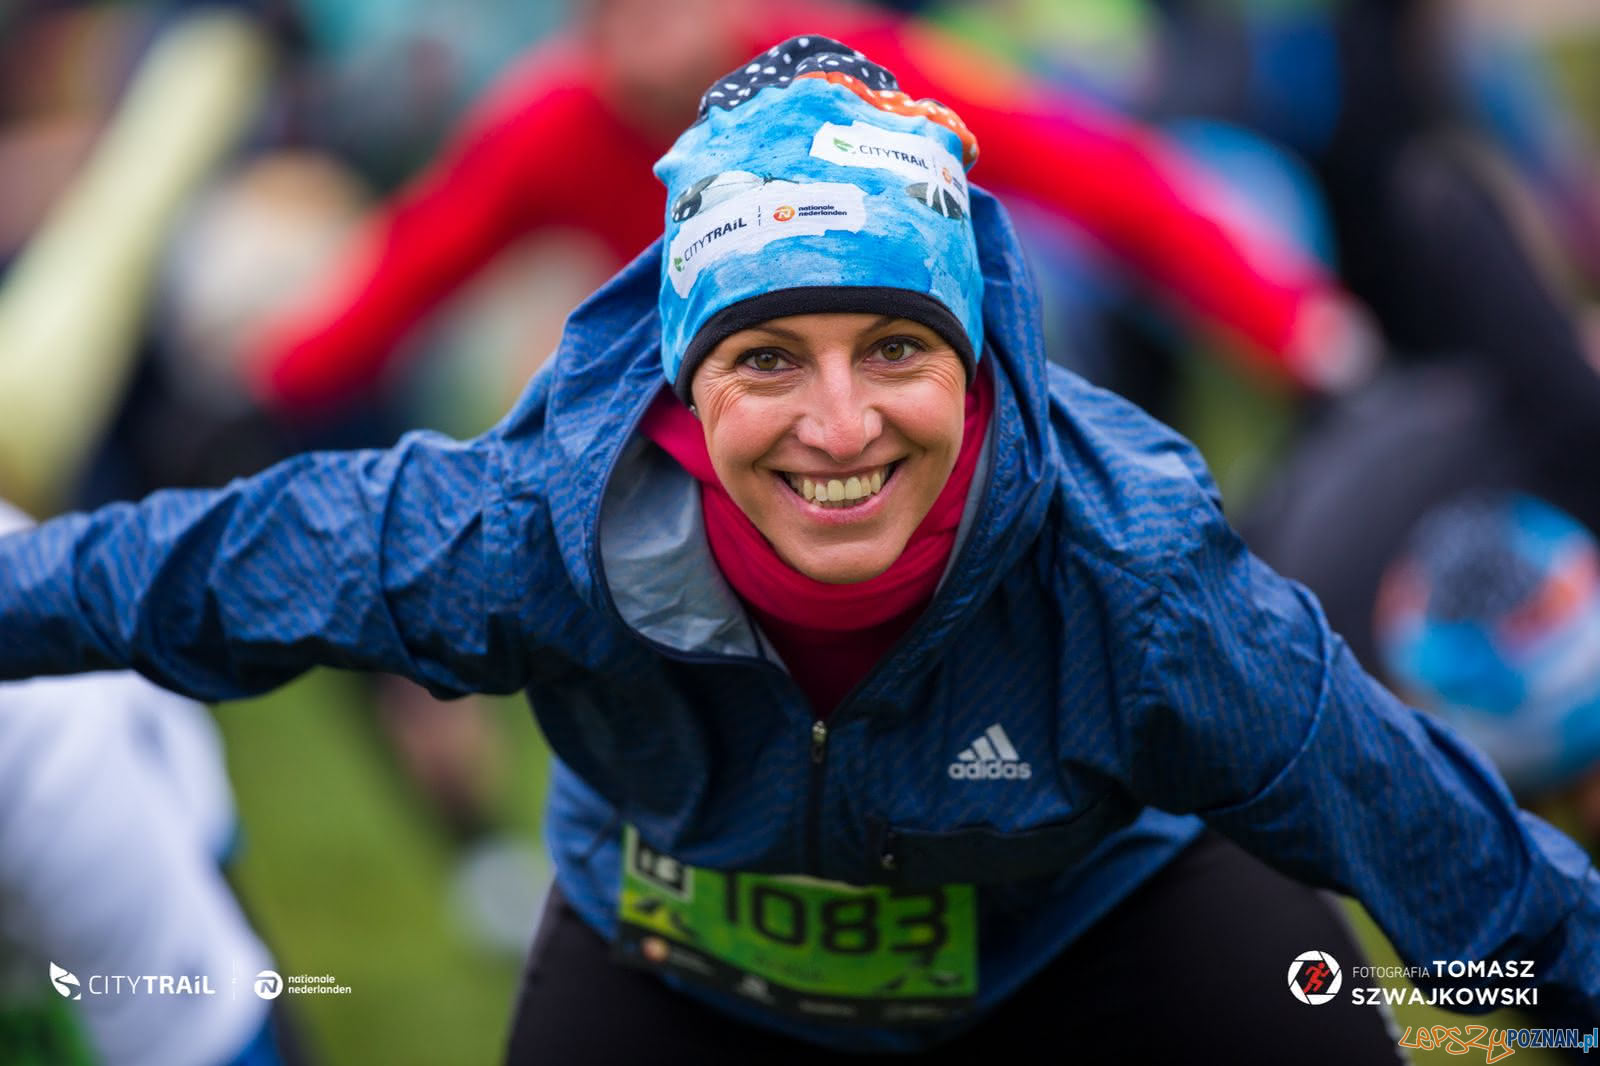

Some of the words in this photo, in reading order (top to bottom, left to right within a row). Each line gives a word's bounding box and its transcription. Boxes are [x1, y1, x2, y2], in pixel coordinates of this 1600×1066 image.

[798, 209, 848, 217] nederlanden
[947, 760, 1032, 780] adidas
[724, 868, 948, 956] 1083
